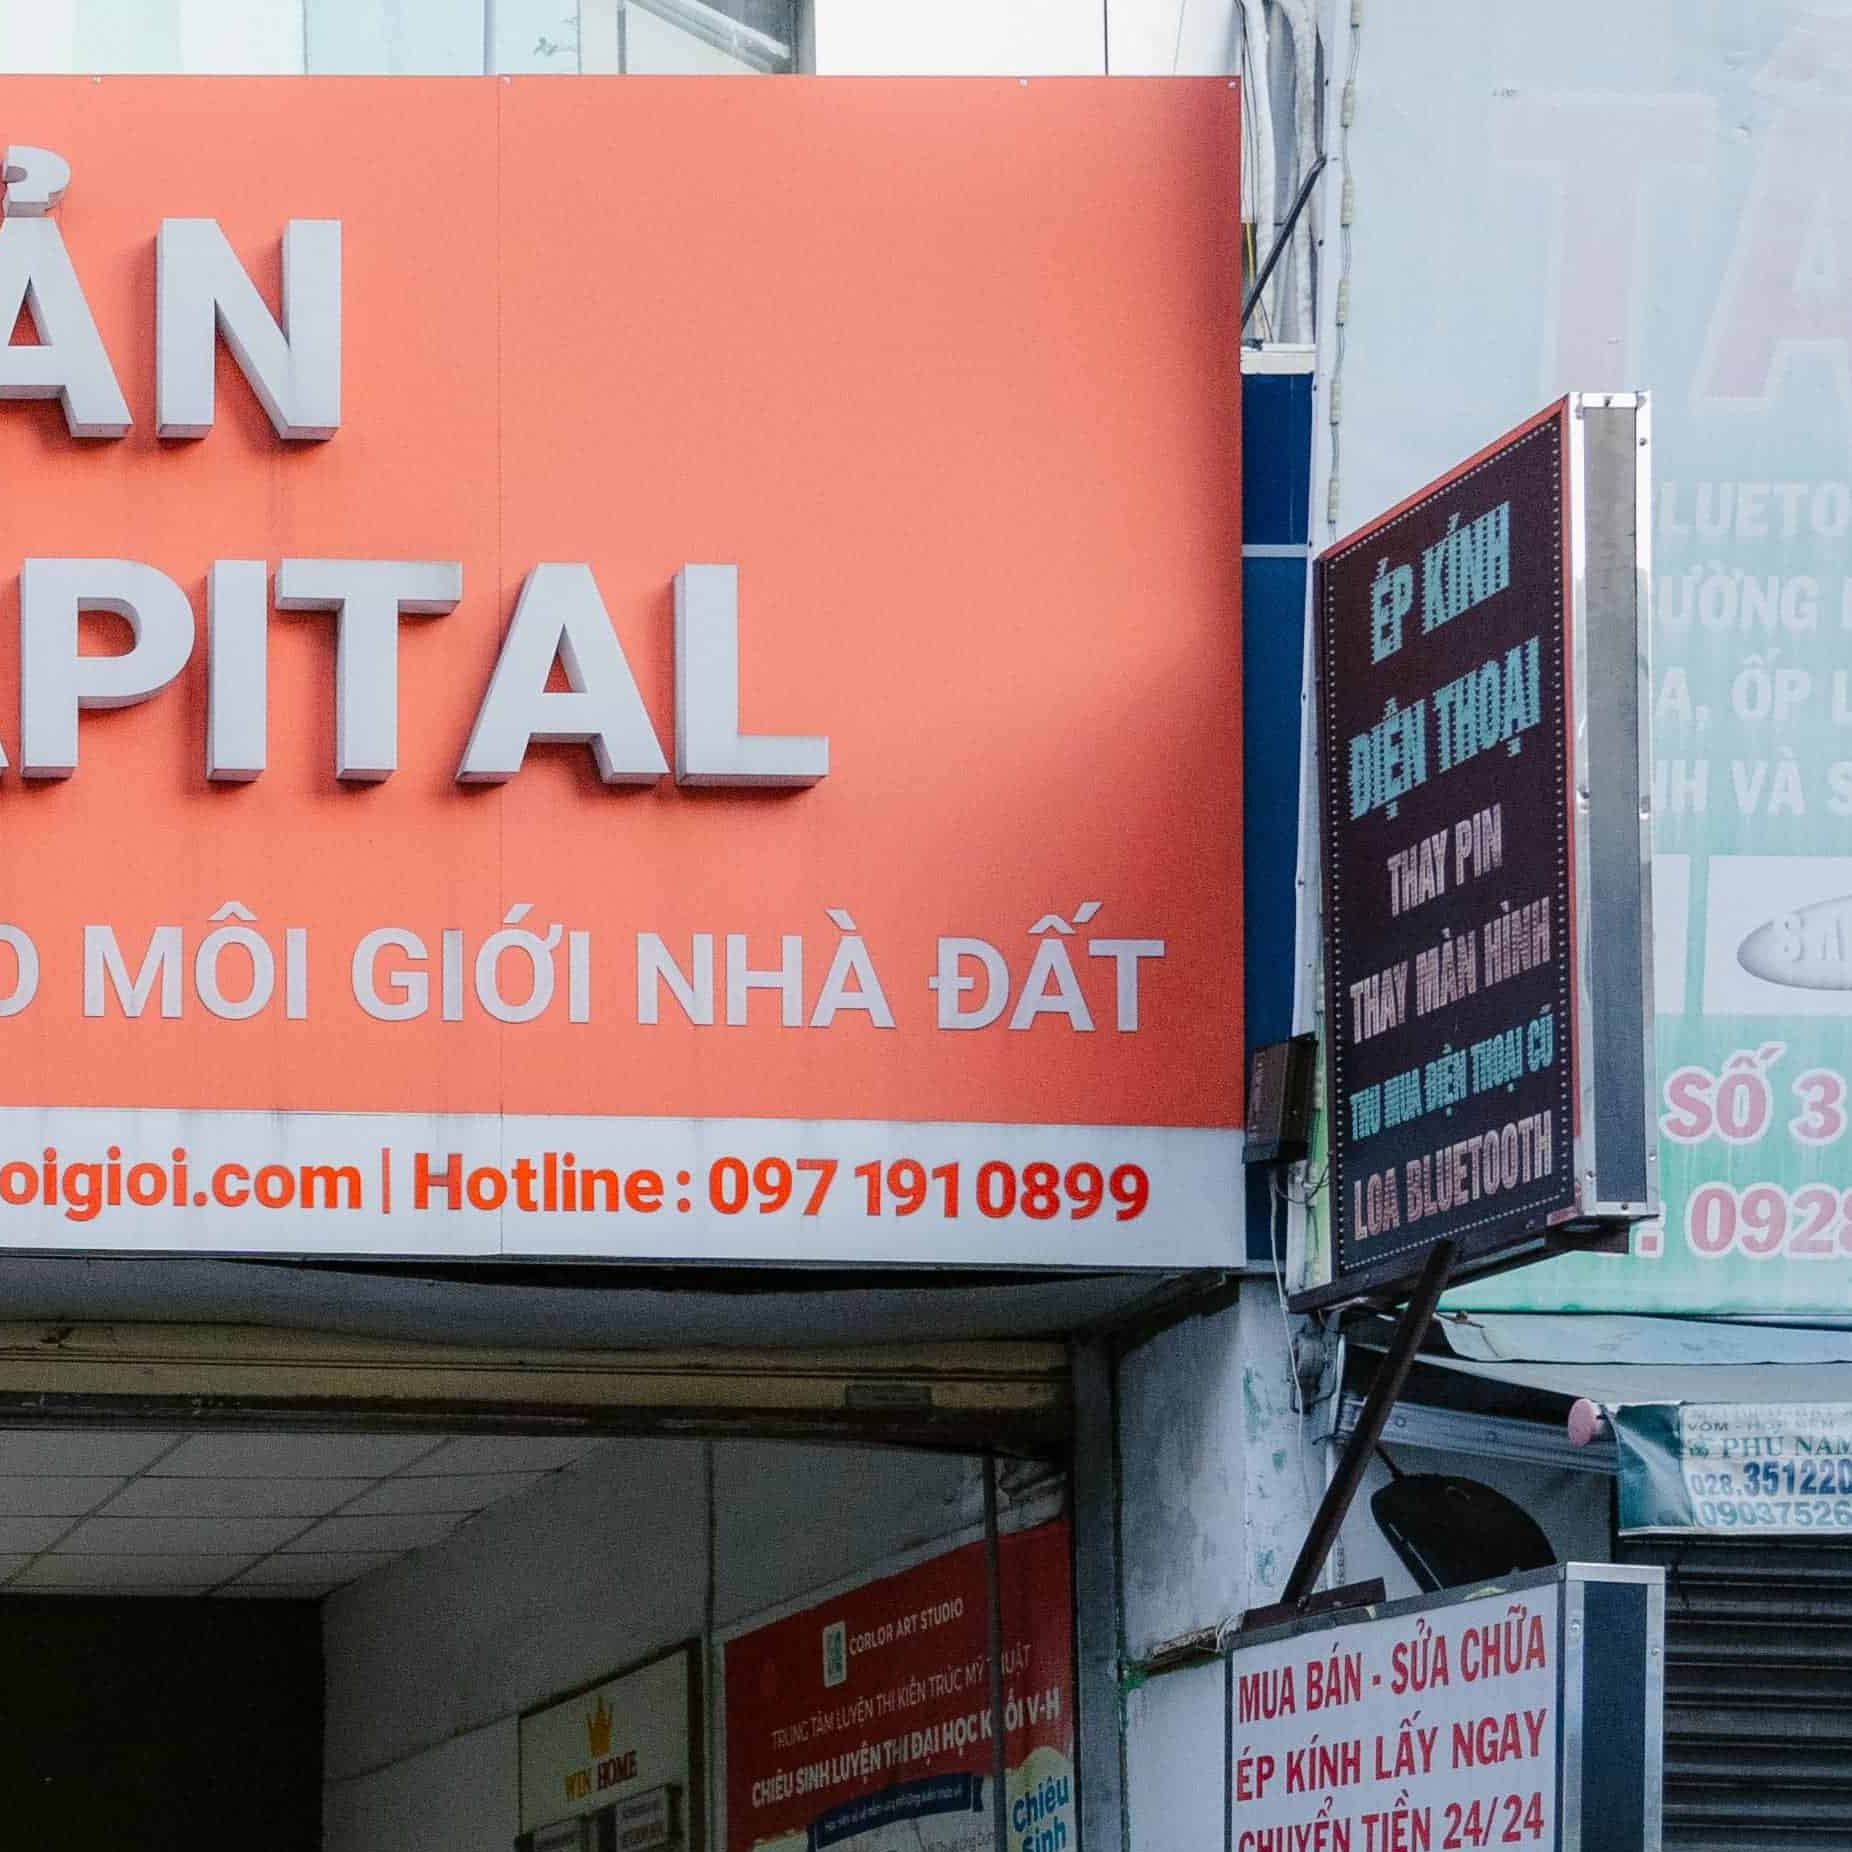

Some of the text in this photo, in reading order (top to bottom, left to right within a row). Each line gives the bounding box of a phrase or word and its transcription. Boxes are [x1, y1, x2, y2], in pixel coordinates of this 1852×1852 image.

[1370, 499, 1511, 665] ÉP KÍNH
[1433, 634, 1541, 775] THOẠI
[1387, 801, 1503, 919] THAY PIN
[82, 900, 306, 1022] MÔI
[352, 903, 589, 1025] GIỚI
[638, 908, 894, 1031] NHÀ
[928, 901, 1164, 1033] ĐẤT
[1349, 896, 1551, 1045] THAY MÀN HÌNH
[1349, 1083, 1382, 1142] THU
[1469, 1025, 1524, 1094] THOẠI
[1662, 1041, 1844, 1141] SỐ 3
[1352, 1108, 1553, 1241] LOA BLUETOOTH
[895, 1617, 919, 1641] ART
[920, 1596, 965, 1631] STUDIO
[1238, 1603, 1546, 1724] MUA BÁN SỬA CHỮA
[596, 1749, 639, 1788] HOME
[751, 1764, 795, 1809] CHIÊU
[795, 1765, 831, 1798] SINH
[1012, 1773, 1072, 1832] Chiêu
[1236, 1707, 1548, 1802] ÉP KÍNH LẤY NGAY
[1442, 1791, 1545, 1850] 24/24
